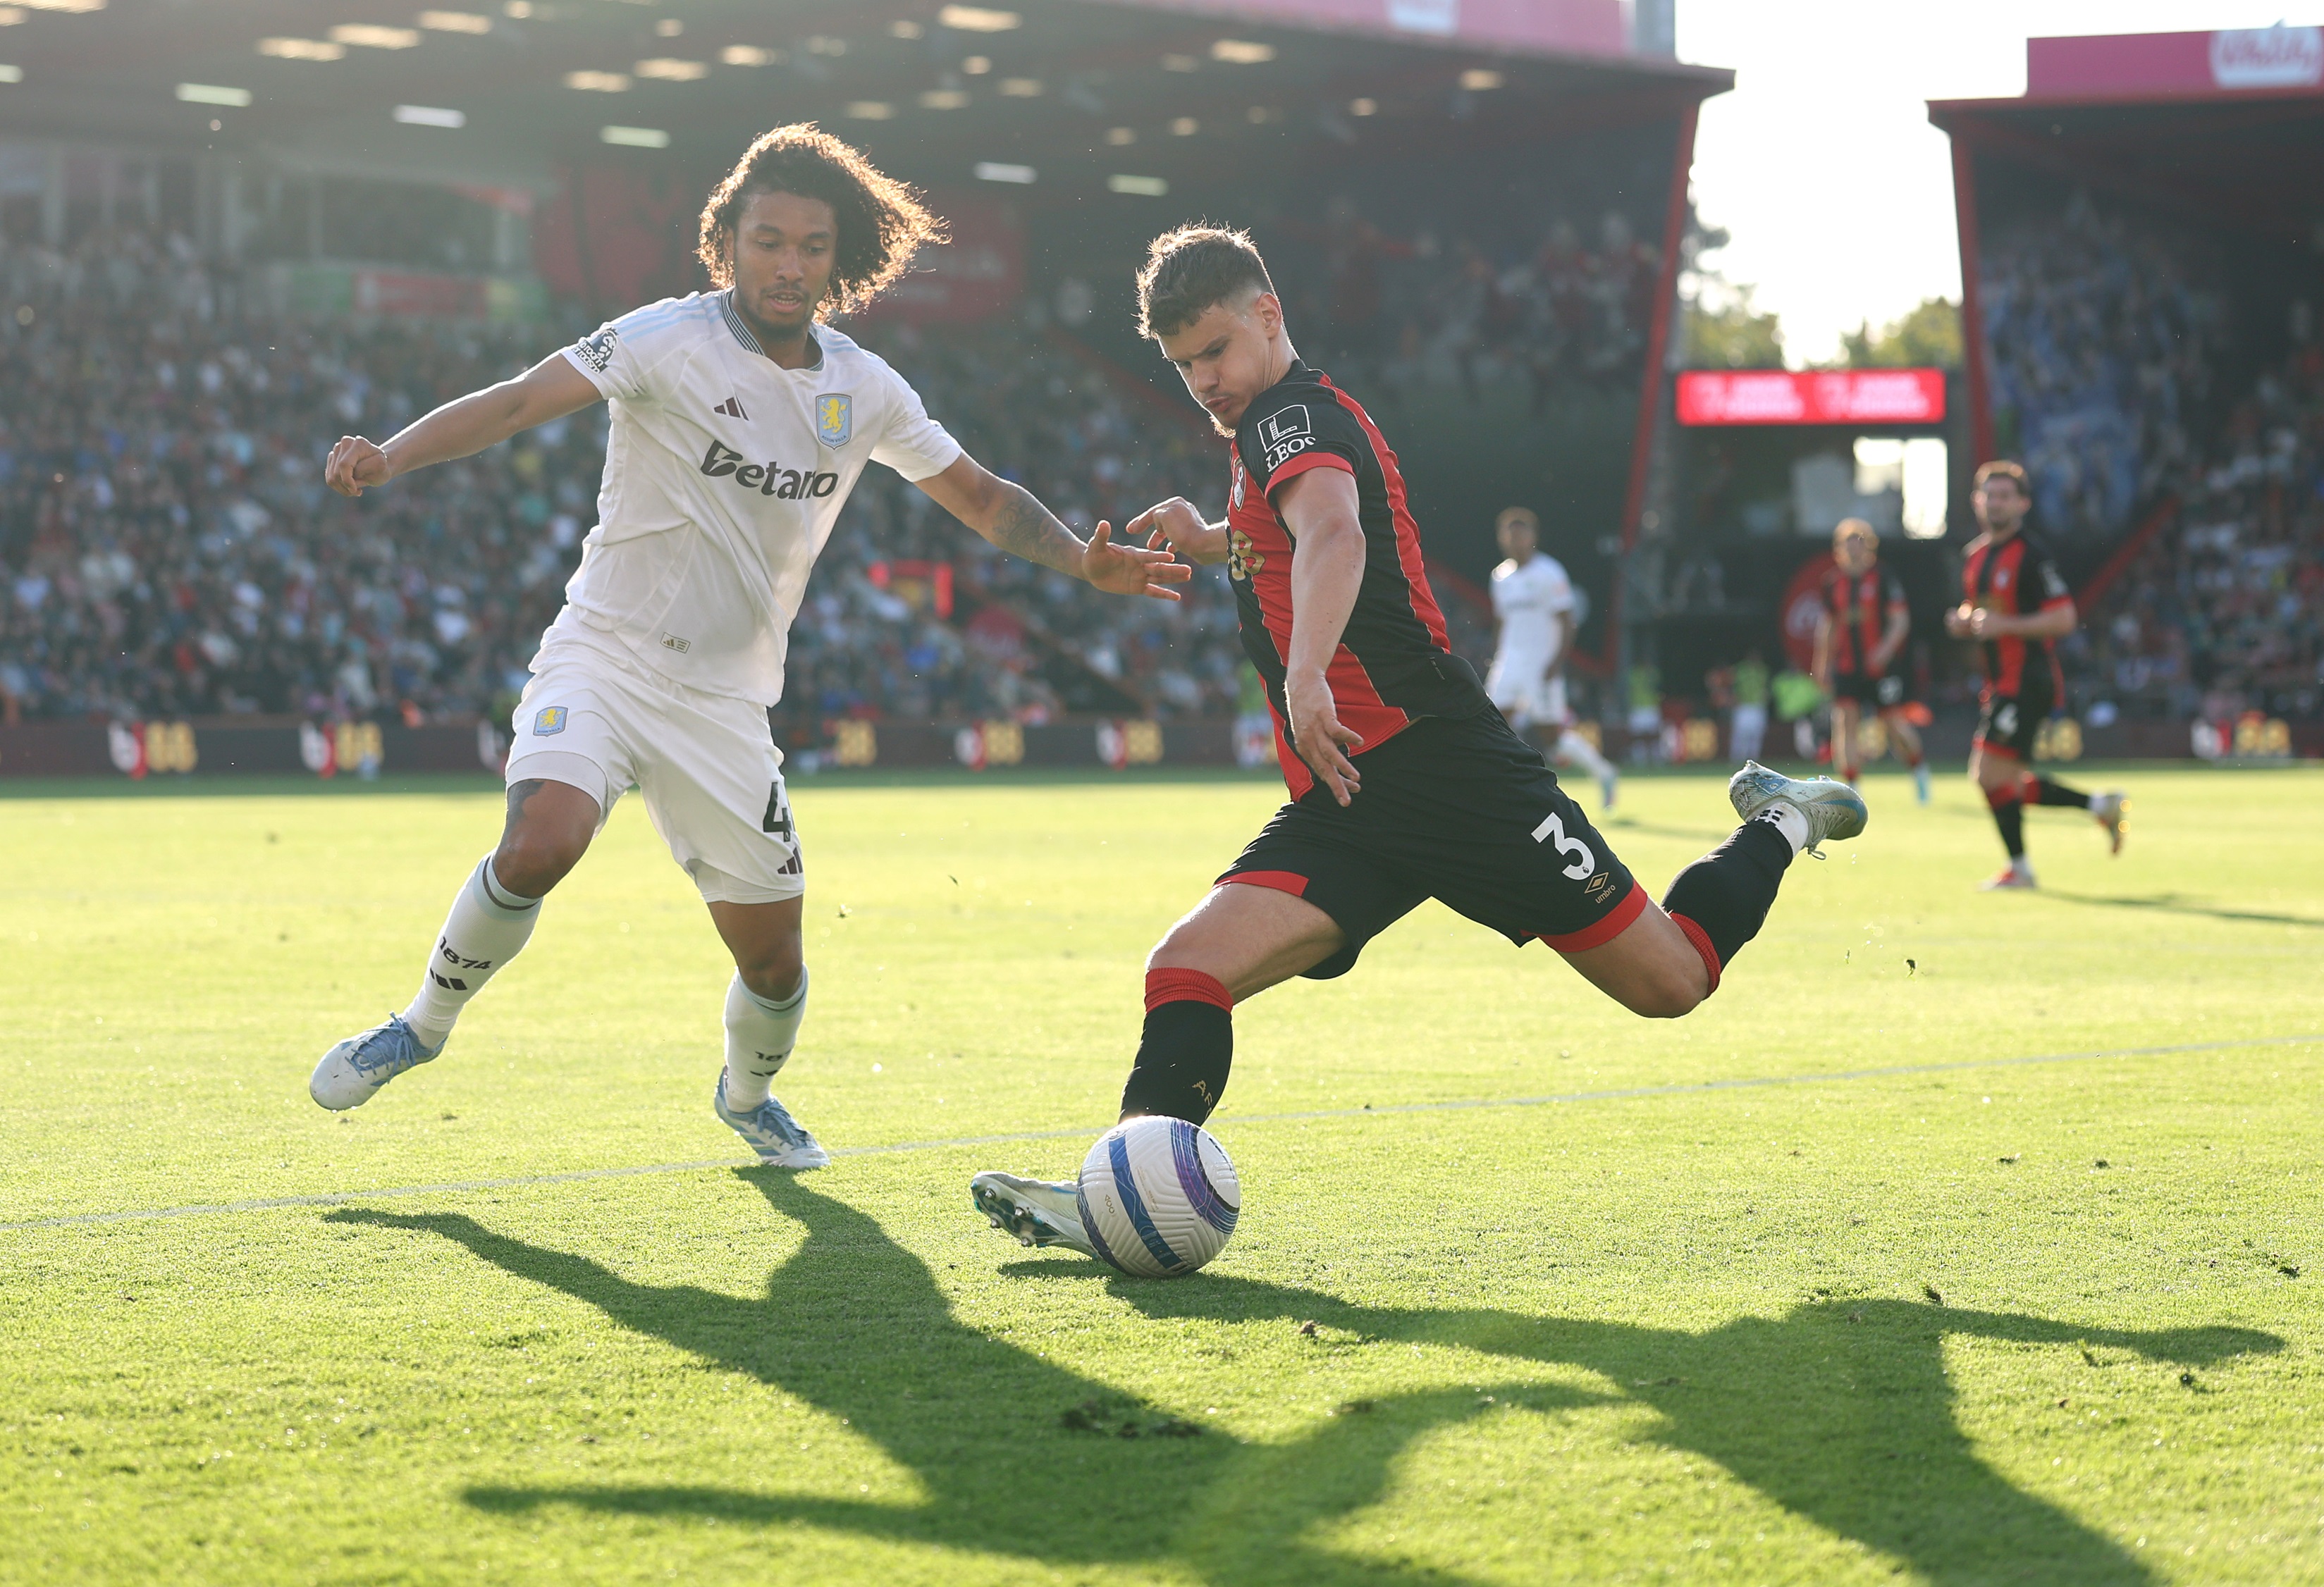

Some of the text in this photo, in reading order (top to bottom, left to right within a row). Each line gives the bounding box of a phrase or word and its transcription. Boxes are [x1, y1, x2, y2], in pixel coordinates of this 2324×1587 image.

[583, 345, 604, 367] room
[700, 440, 838, 500] Betano
[1530, 812, 1595, 880] 3
[1595, 884, 1616, 904] umbro
[440, 937, 492, 969] 1874
